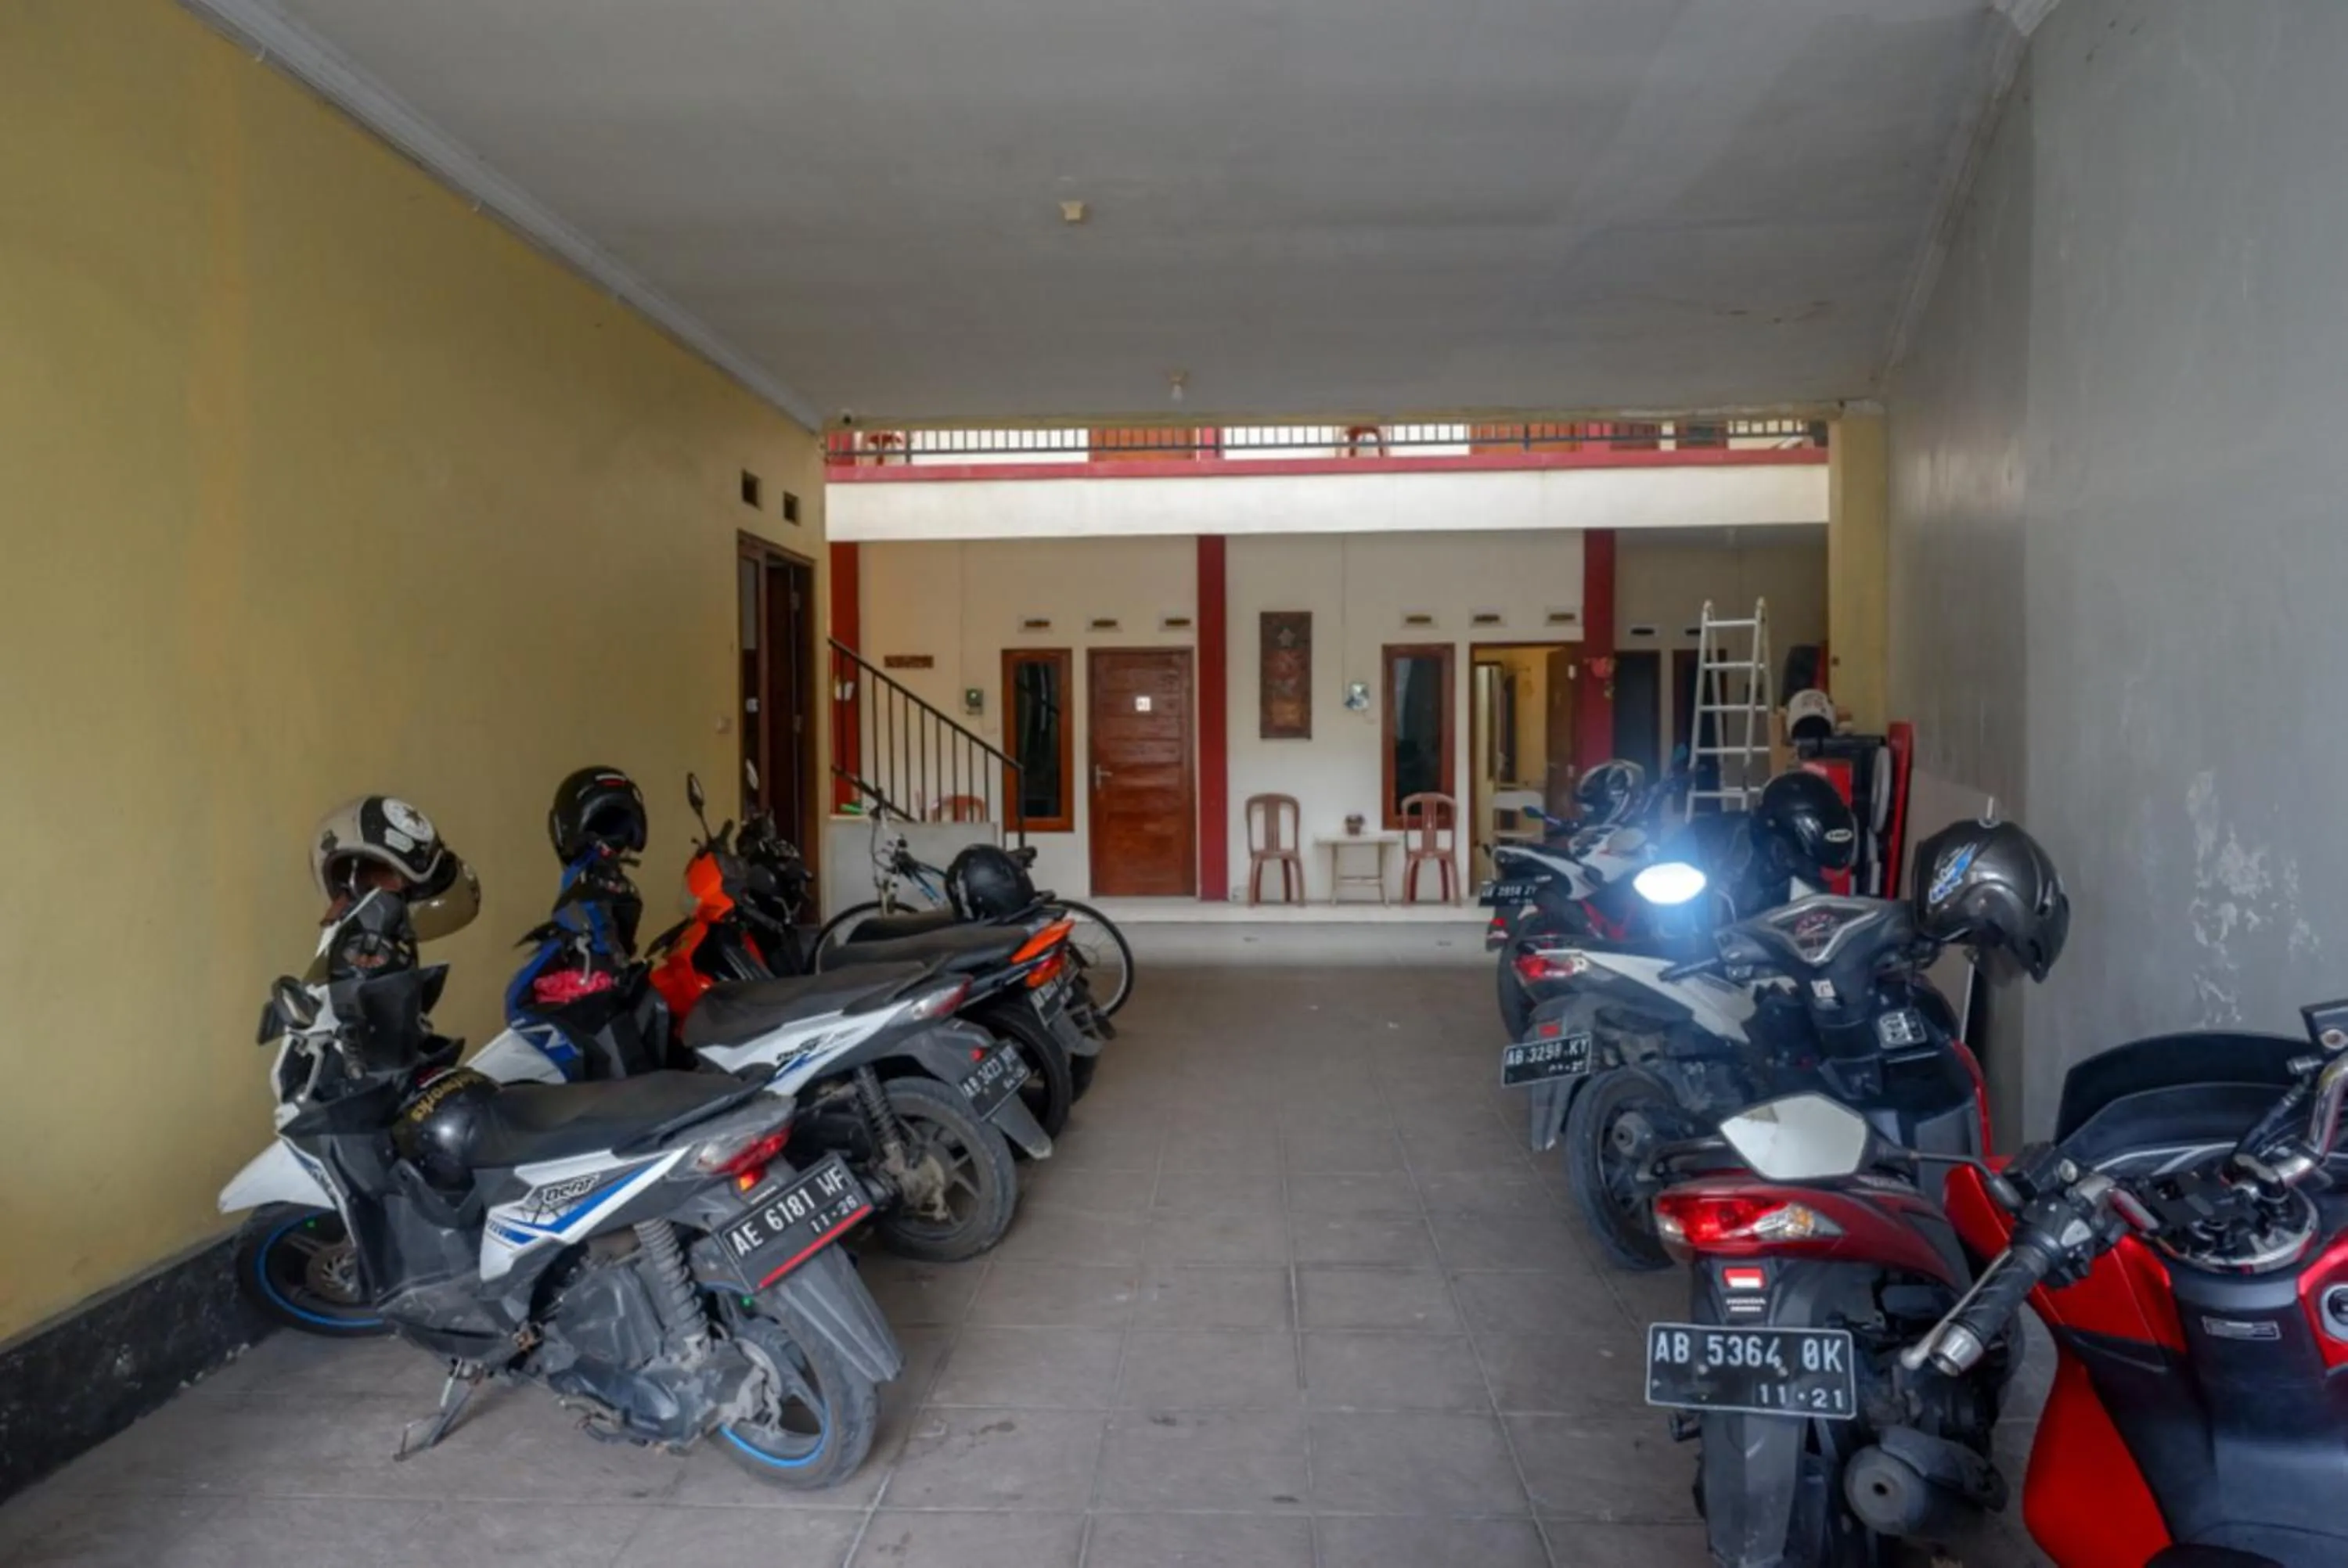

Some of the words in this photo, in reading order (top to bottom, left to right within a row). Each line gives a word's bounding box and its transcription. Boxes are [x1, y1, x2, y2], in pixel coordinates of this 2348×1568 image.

[1506, 1048, 1525, 1066] AB
[729, 1220, 764, 1257] AE
[764, 1187, 816, 1232] 6181
[816, 1166, 846, 1197] WF
[1654, 1330, 1690, 1363] AB
[1706, 1333, 1781, 1369] 5364
